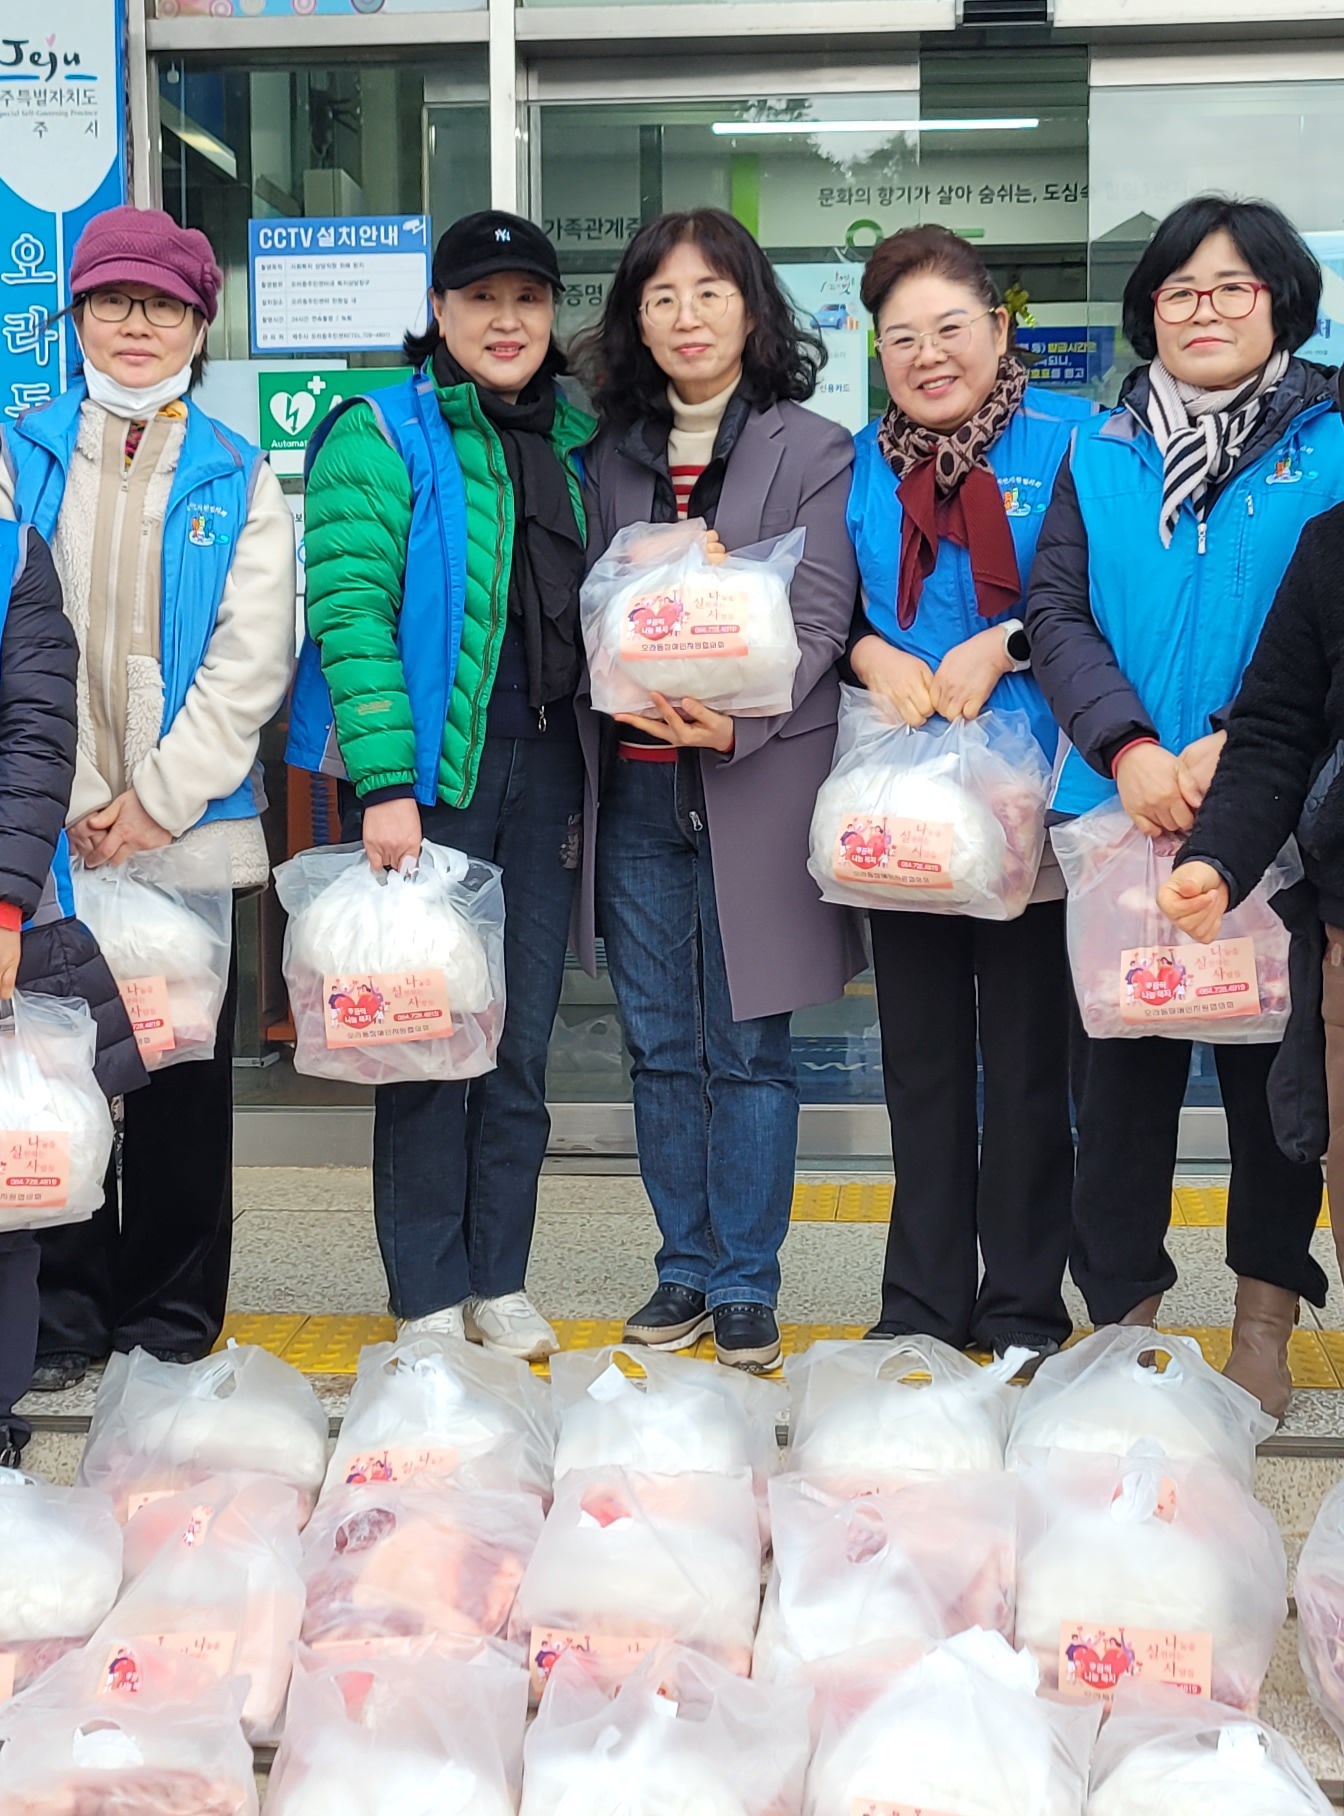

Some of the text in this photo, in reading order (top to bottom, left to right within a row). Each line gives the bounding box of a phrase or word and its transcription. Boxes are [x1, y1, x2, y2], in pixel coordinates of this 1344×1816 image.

[818, 186, 871, 206] 문화의
[877, 184, 931, 206] 향기가
[937, 184, 972, 206] 살아
[978, 183, 1037, 205] 숨쉬는,
[259, 225, 398, 249] CCTV 설치안내
